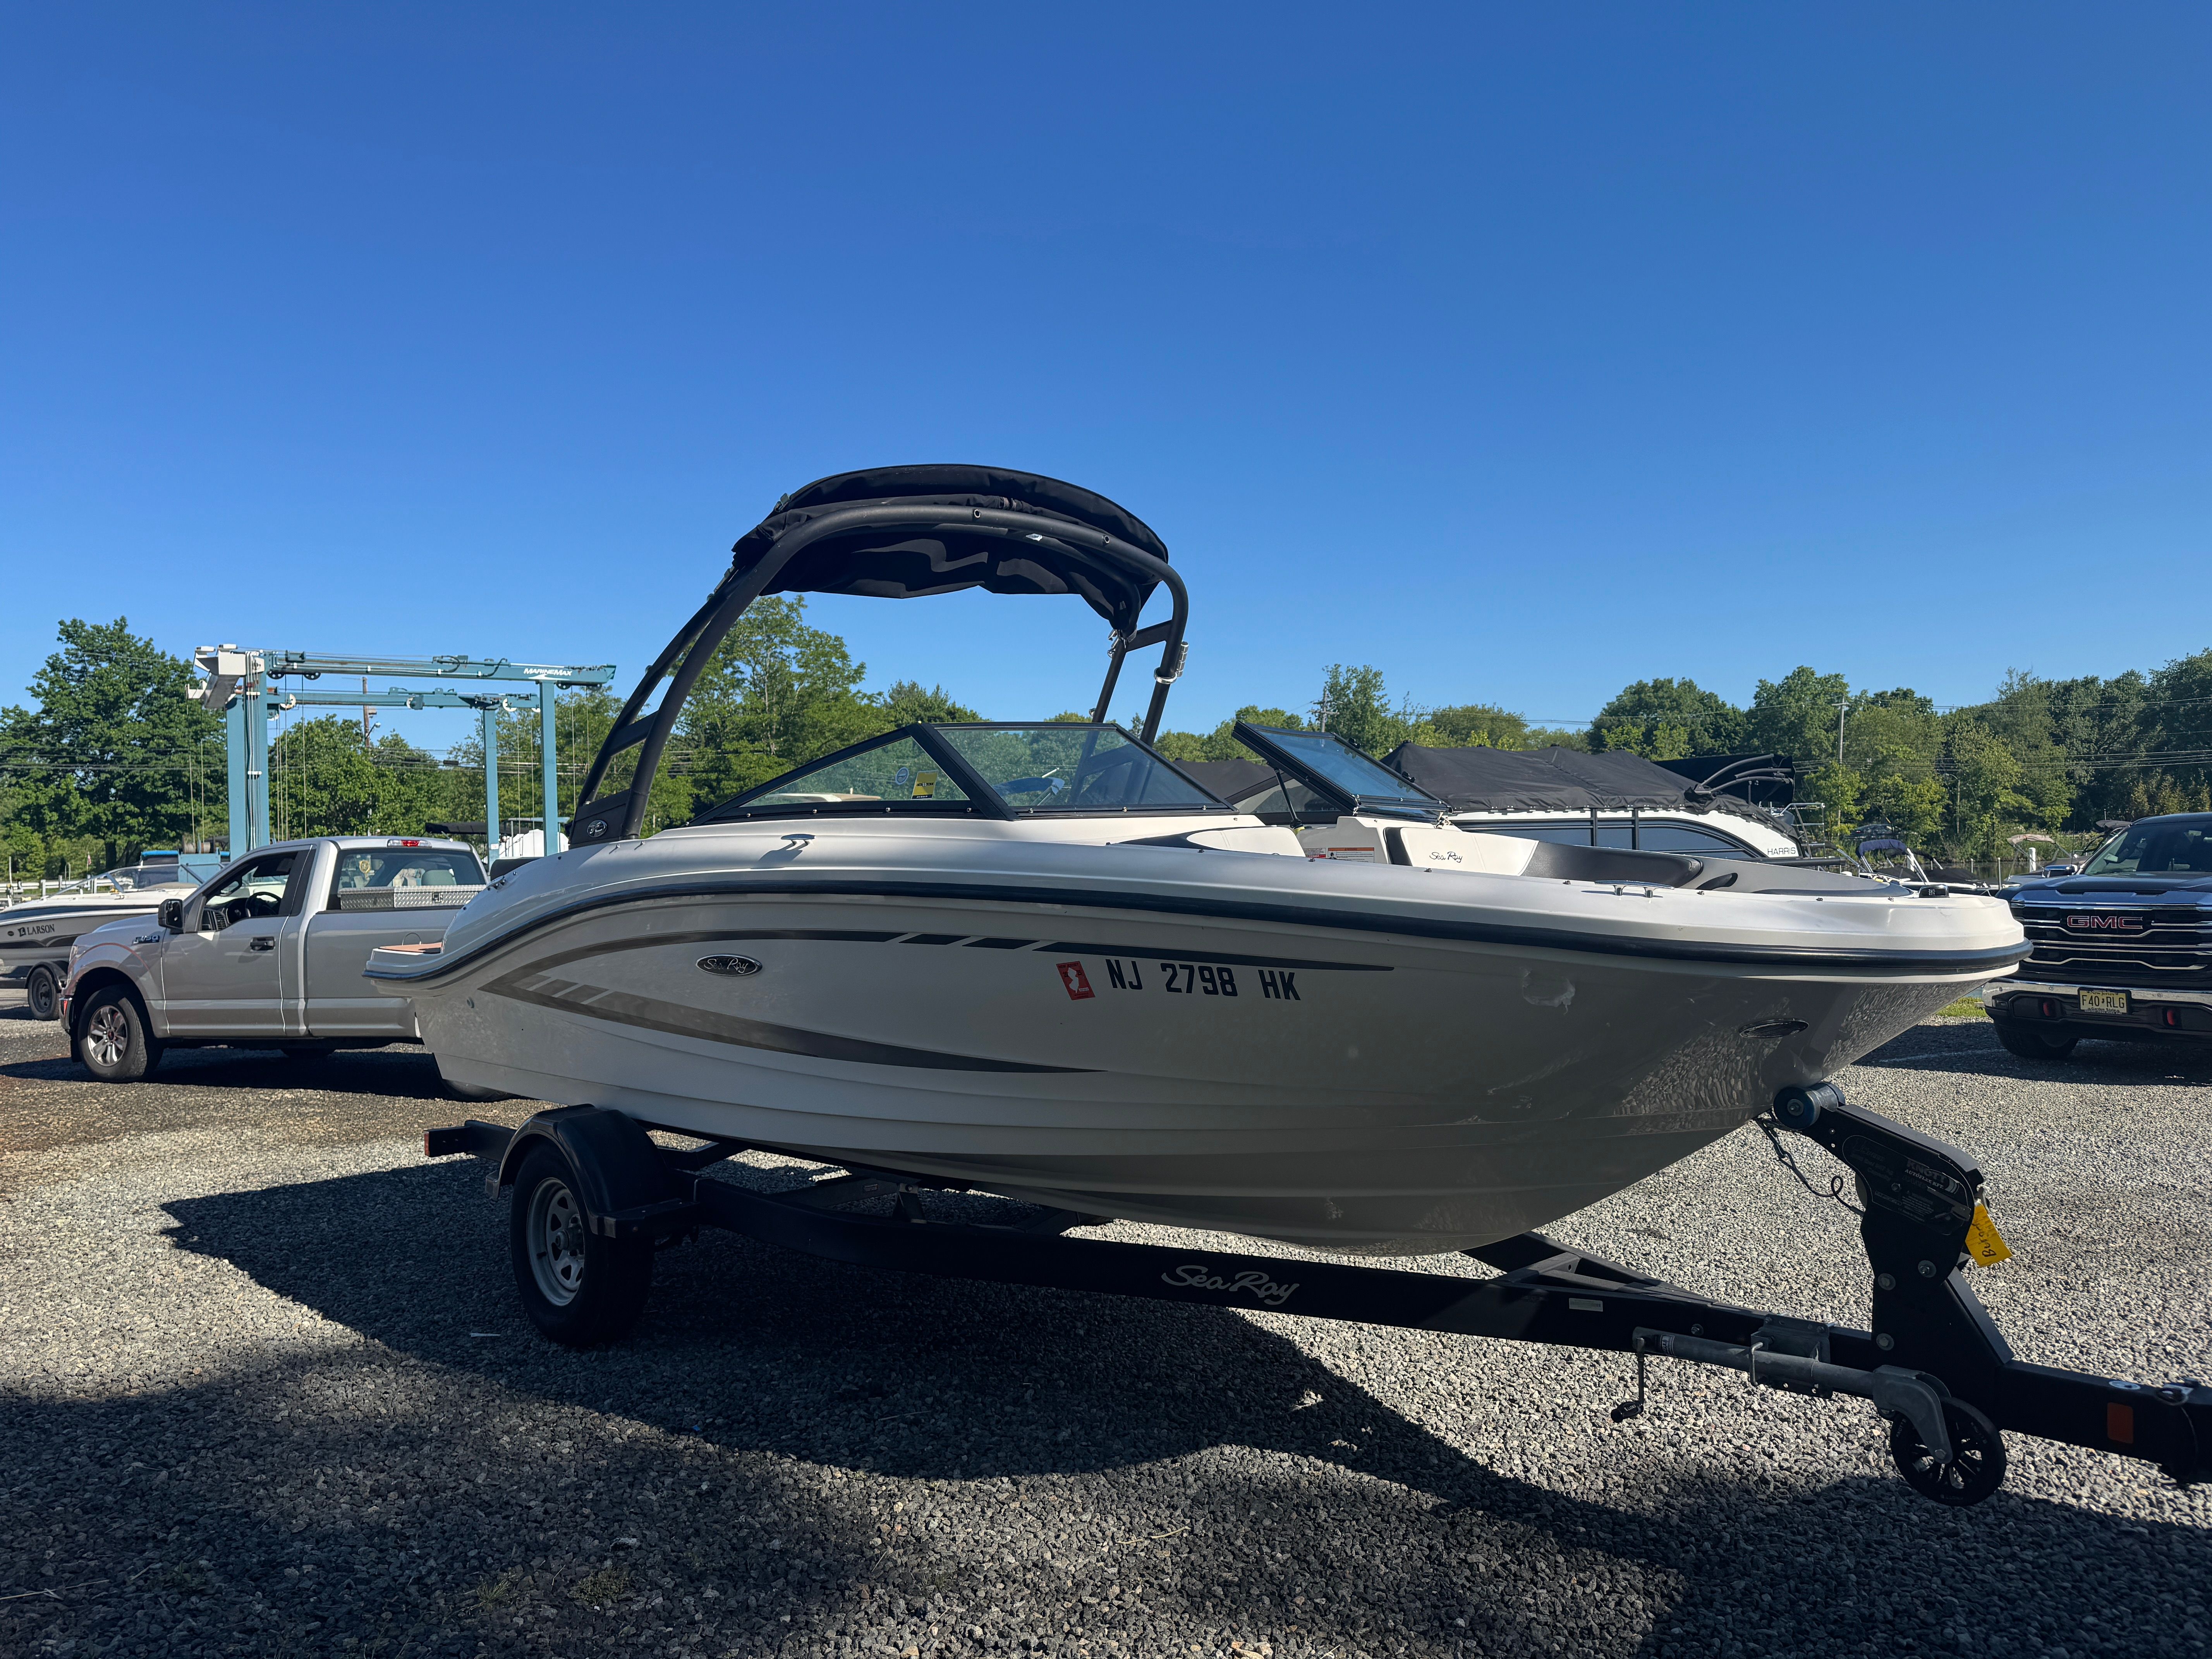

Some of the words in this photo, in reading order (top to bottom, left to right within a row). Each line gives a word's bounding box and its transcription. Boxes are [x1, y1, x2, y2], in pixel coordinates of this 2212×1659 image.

[1429, 852, 1446, 860] Sea
[1447, 851, 1463, 863] Ray
[2067, 915, 2143, 929] GMC
[27, 924, 55, 935] LARSON
[704, 958, 724, 970] Sea
[726, 957, 749, 973] Ray
[1106, 959, 1143, 990] NJ
[1160, 963, 1238, 996] 2798
[1258, 970, 1301, 1000] HK
[2082, 995, 2099, 1006] F40
[2106, 996, 2124, 1008] RLG
[1161, 1265, 1231, 1289] Sea
[1229, 1271, 1300, 1305] Ray
